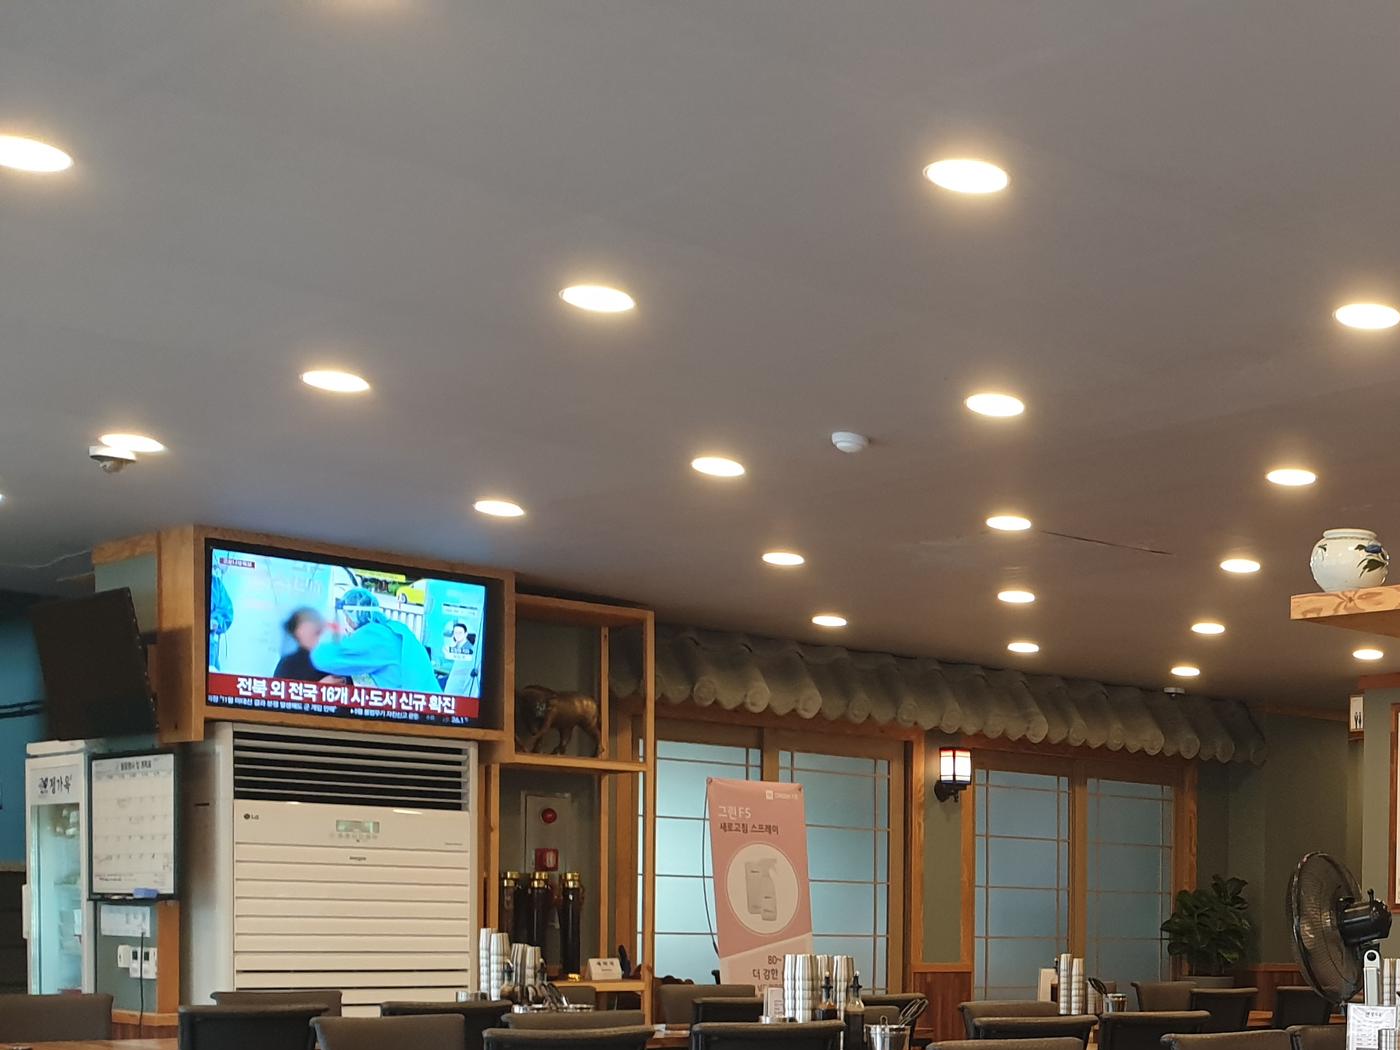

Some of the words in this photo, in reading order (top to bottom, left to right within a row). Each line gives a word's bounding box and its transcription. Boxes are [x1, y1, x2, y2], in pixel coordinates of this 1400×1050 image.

[237, 677, 268, 698] 전북
[270, 680, 285, 699] 외
[288, 682, 318, 702] 전국
[320, 685, 348, 705] 16개
[350, 688, 397, 710] 시·도서
[399, 691, 426, 711] 신규
[428, 695, 456, 714] 확진
[720, 822, 748, 834] 새로고침
[751, 823, 779, 835] 스프레이
[752, 968, 760, 980] 더
[763, 968, 778, 980] 강한
